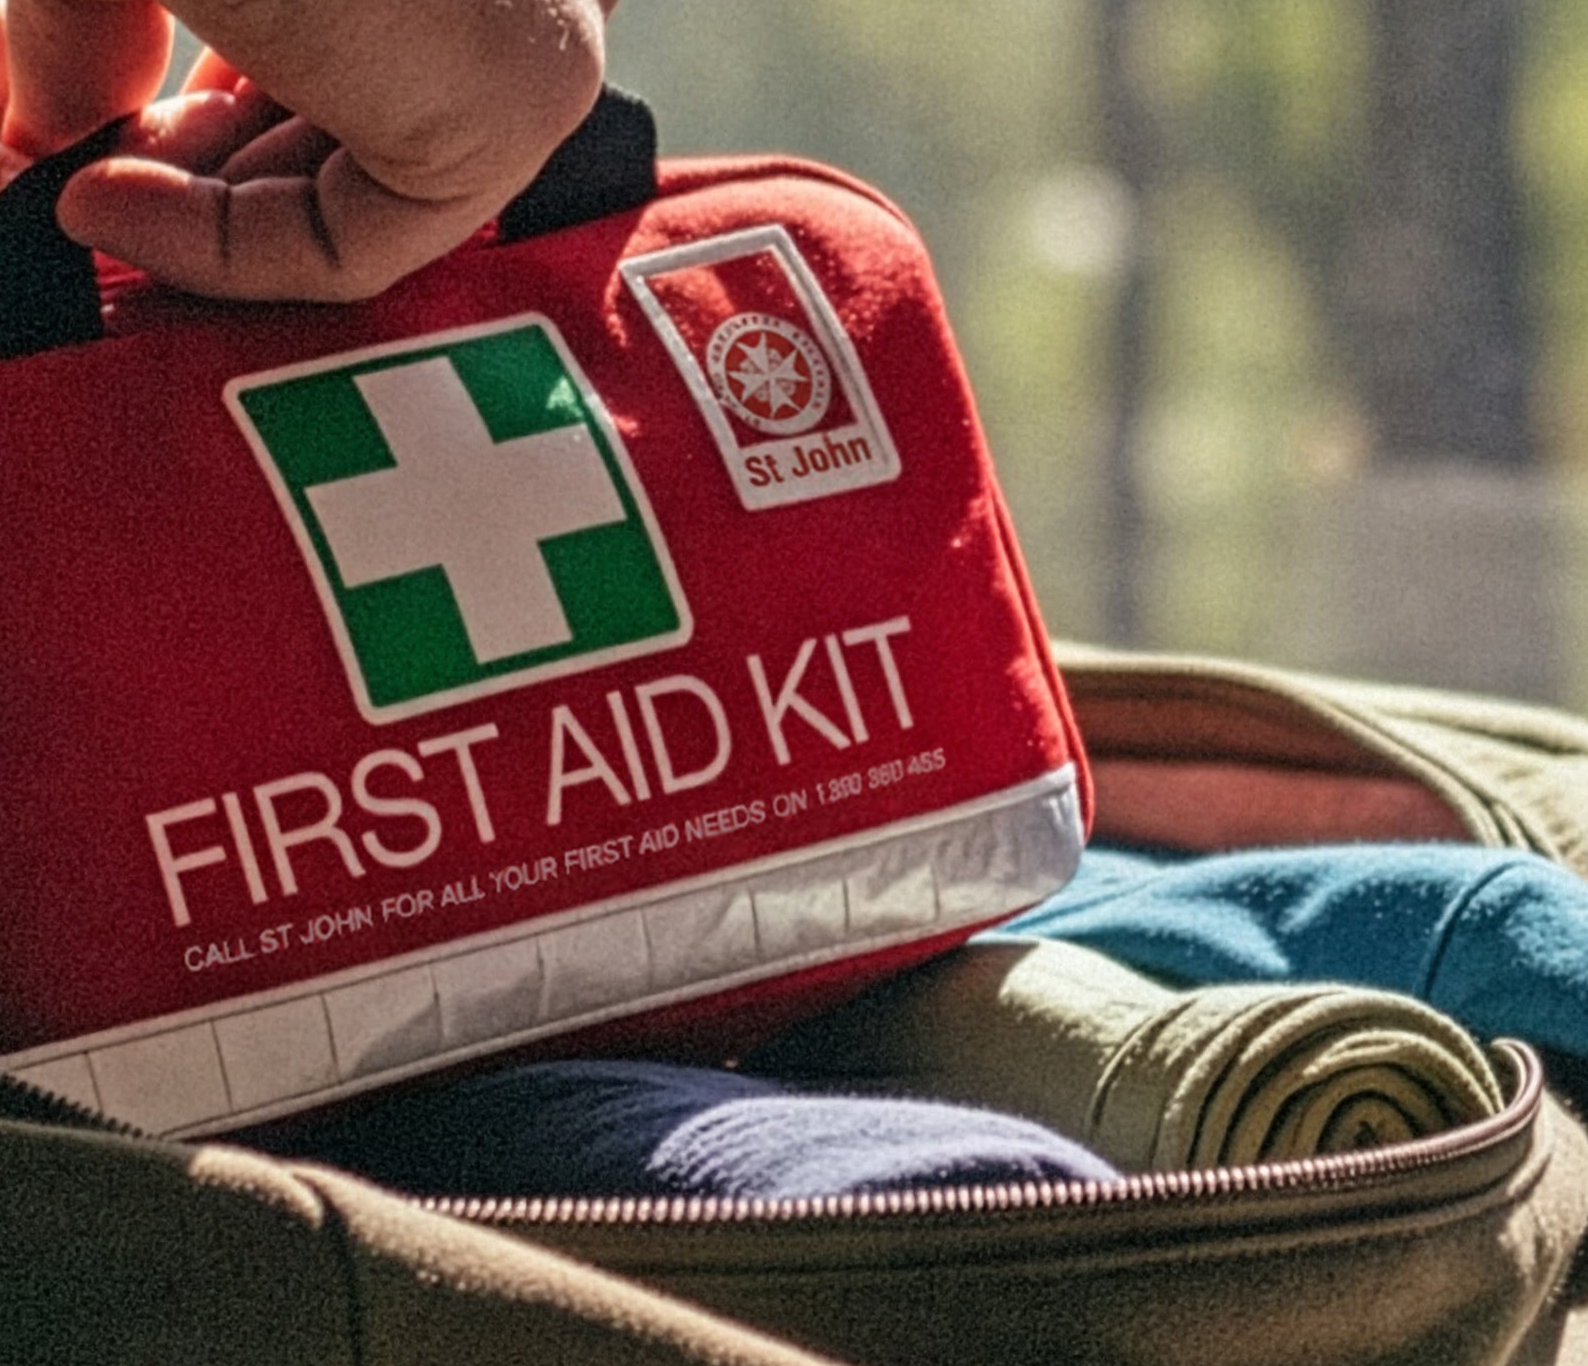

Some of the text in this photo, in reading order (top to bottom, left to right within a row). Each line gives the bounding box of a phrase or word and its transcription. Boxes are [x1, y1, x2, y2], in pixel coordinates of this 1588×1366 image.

[744, 433, 872, 487] St John
[145, 615, 914, 928] FIRST AID KIT
[183, 937, 257, 972] CALL
[259, 923, 293, 955] ST
[299, 904, 373, 945] JOHN
[380, 889, 435, 923] FOR
[440, 874, 486, 907] ALL
[488, 856, 558, 893] YOUR
[564, 835, 634, 875] FIRST
[638, 822, 681, 855] AID
[684, 800, 766, 843] NEEDS
[772, 788, 808, 818] ON
